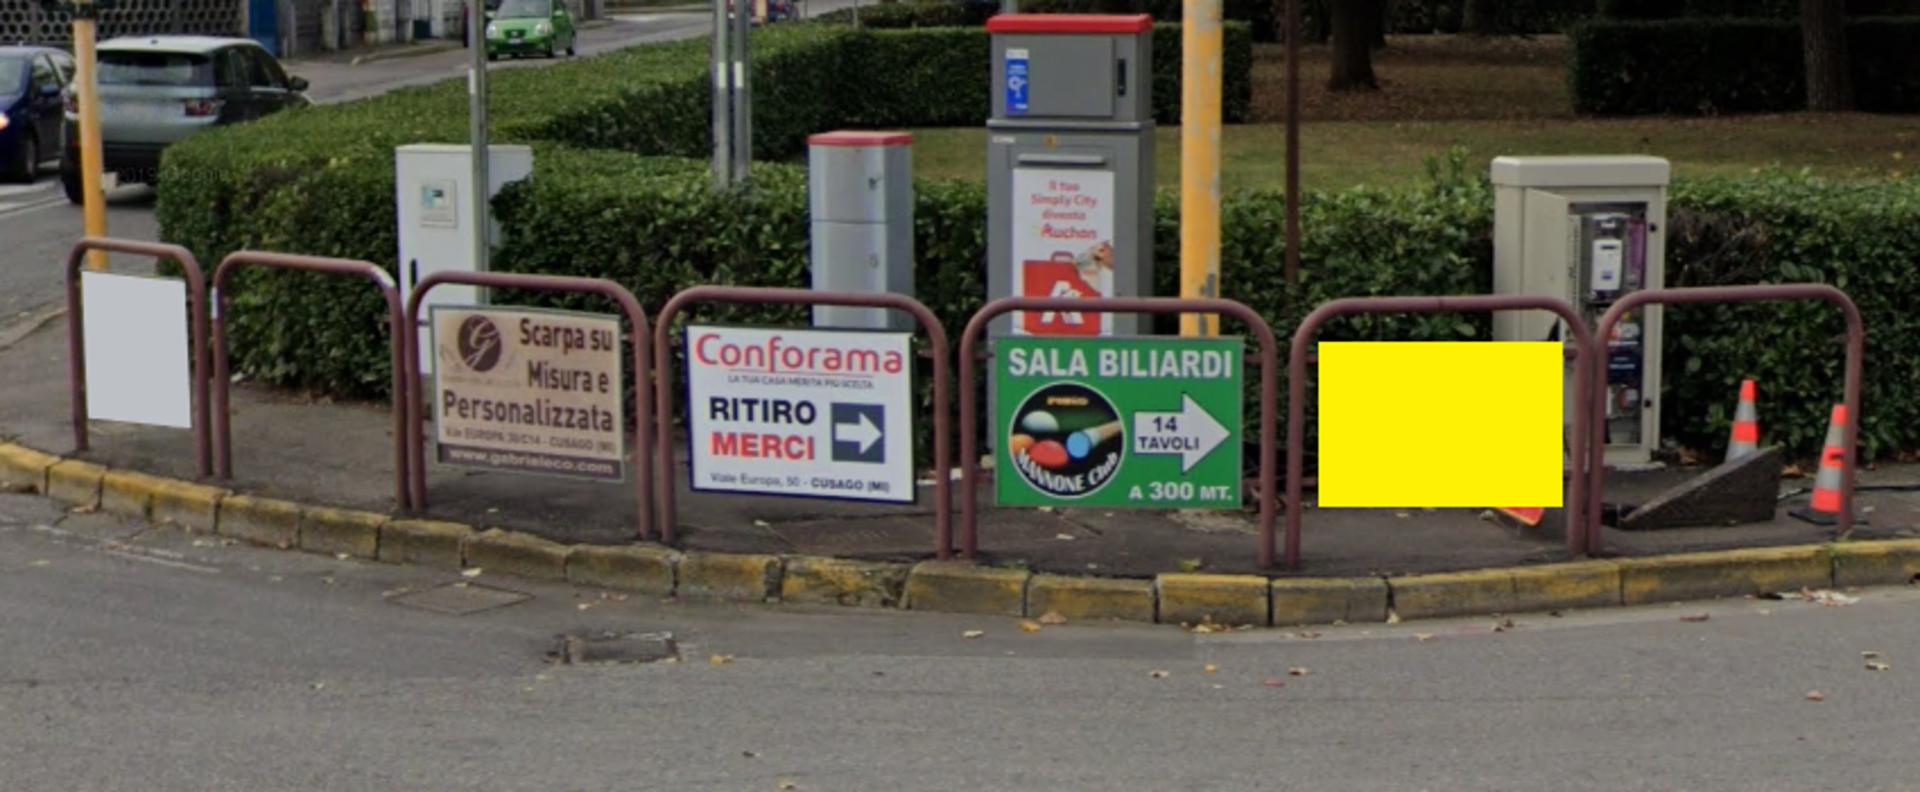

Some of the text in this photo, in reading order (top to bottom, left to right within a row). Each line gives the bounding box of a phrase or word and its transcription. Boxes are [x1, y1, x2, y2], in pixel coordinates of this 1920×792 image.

[1073, 194, 1098, 208] City
[1041, 222, 1098, 240] Auchan
[520, 317, 613, 355] Scarpa su
[695, 333, 904, 375] Conforama
[1008, 348, 1232, 379] SALA BILIARDI
[528, 360, 593, 393] Misura
[597, 372, 609, 393] e
[728, 374, 740, 384] LA
[742, 375, 760, 384] TUA
[761, 375, 786, 386] CASA
[788, 377, 822, 387] MERITA
[443, 389, 613, 432] Personalizzata
[709, 396, 817, 425] RITIRO
[1152, 416, 1177, 432] 14
[463, 427, 504, 442] EUROPA
[549, 436, 593, 451] CUSAGO
[709, 431, 816, 461] MERCI
[1138, 435, 1200, 451] TAVOLI
[449, 449, 614, 475] www.gabrieleco.com
[709, 472, 737, 485] Viale
[810, 477, 864, 491] CUSAGO
[867, 480, 890, 493] (MI)
[1128, 481, 1234, 501] A 300 MT.
